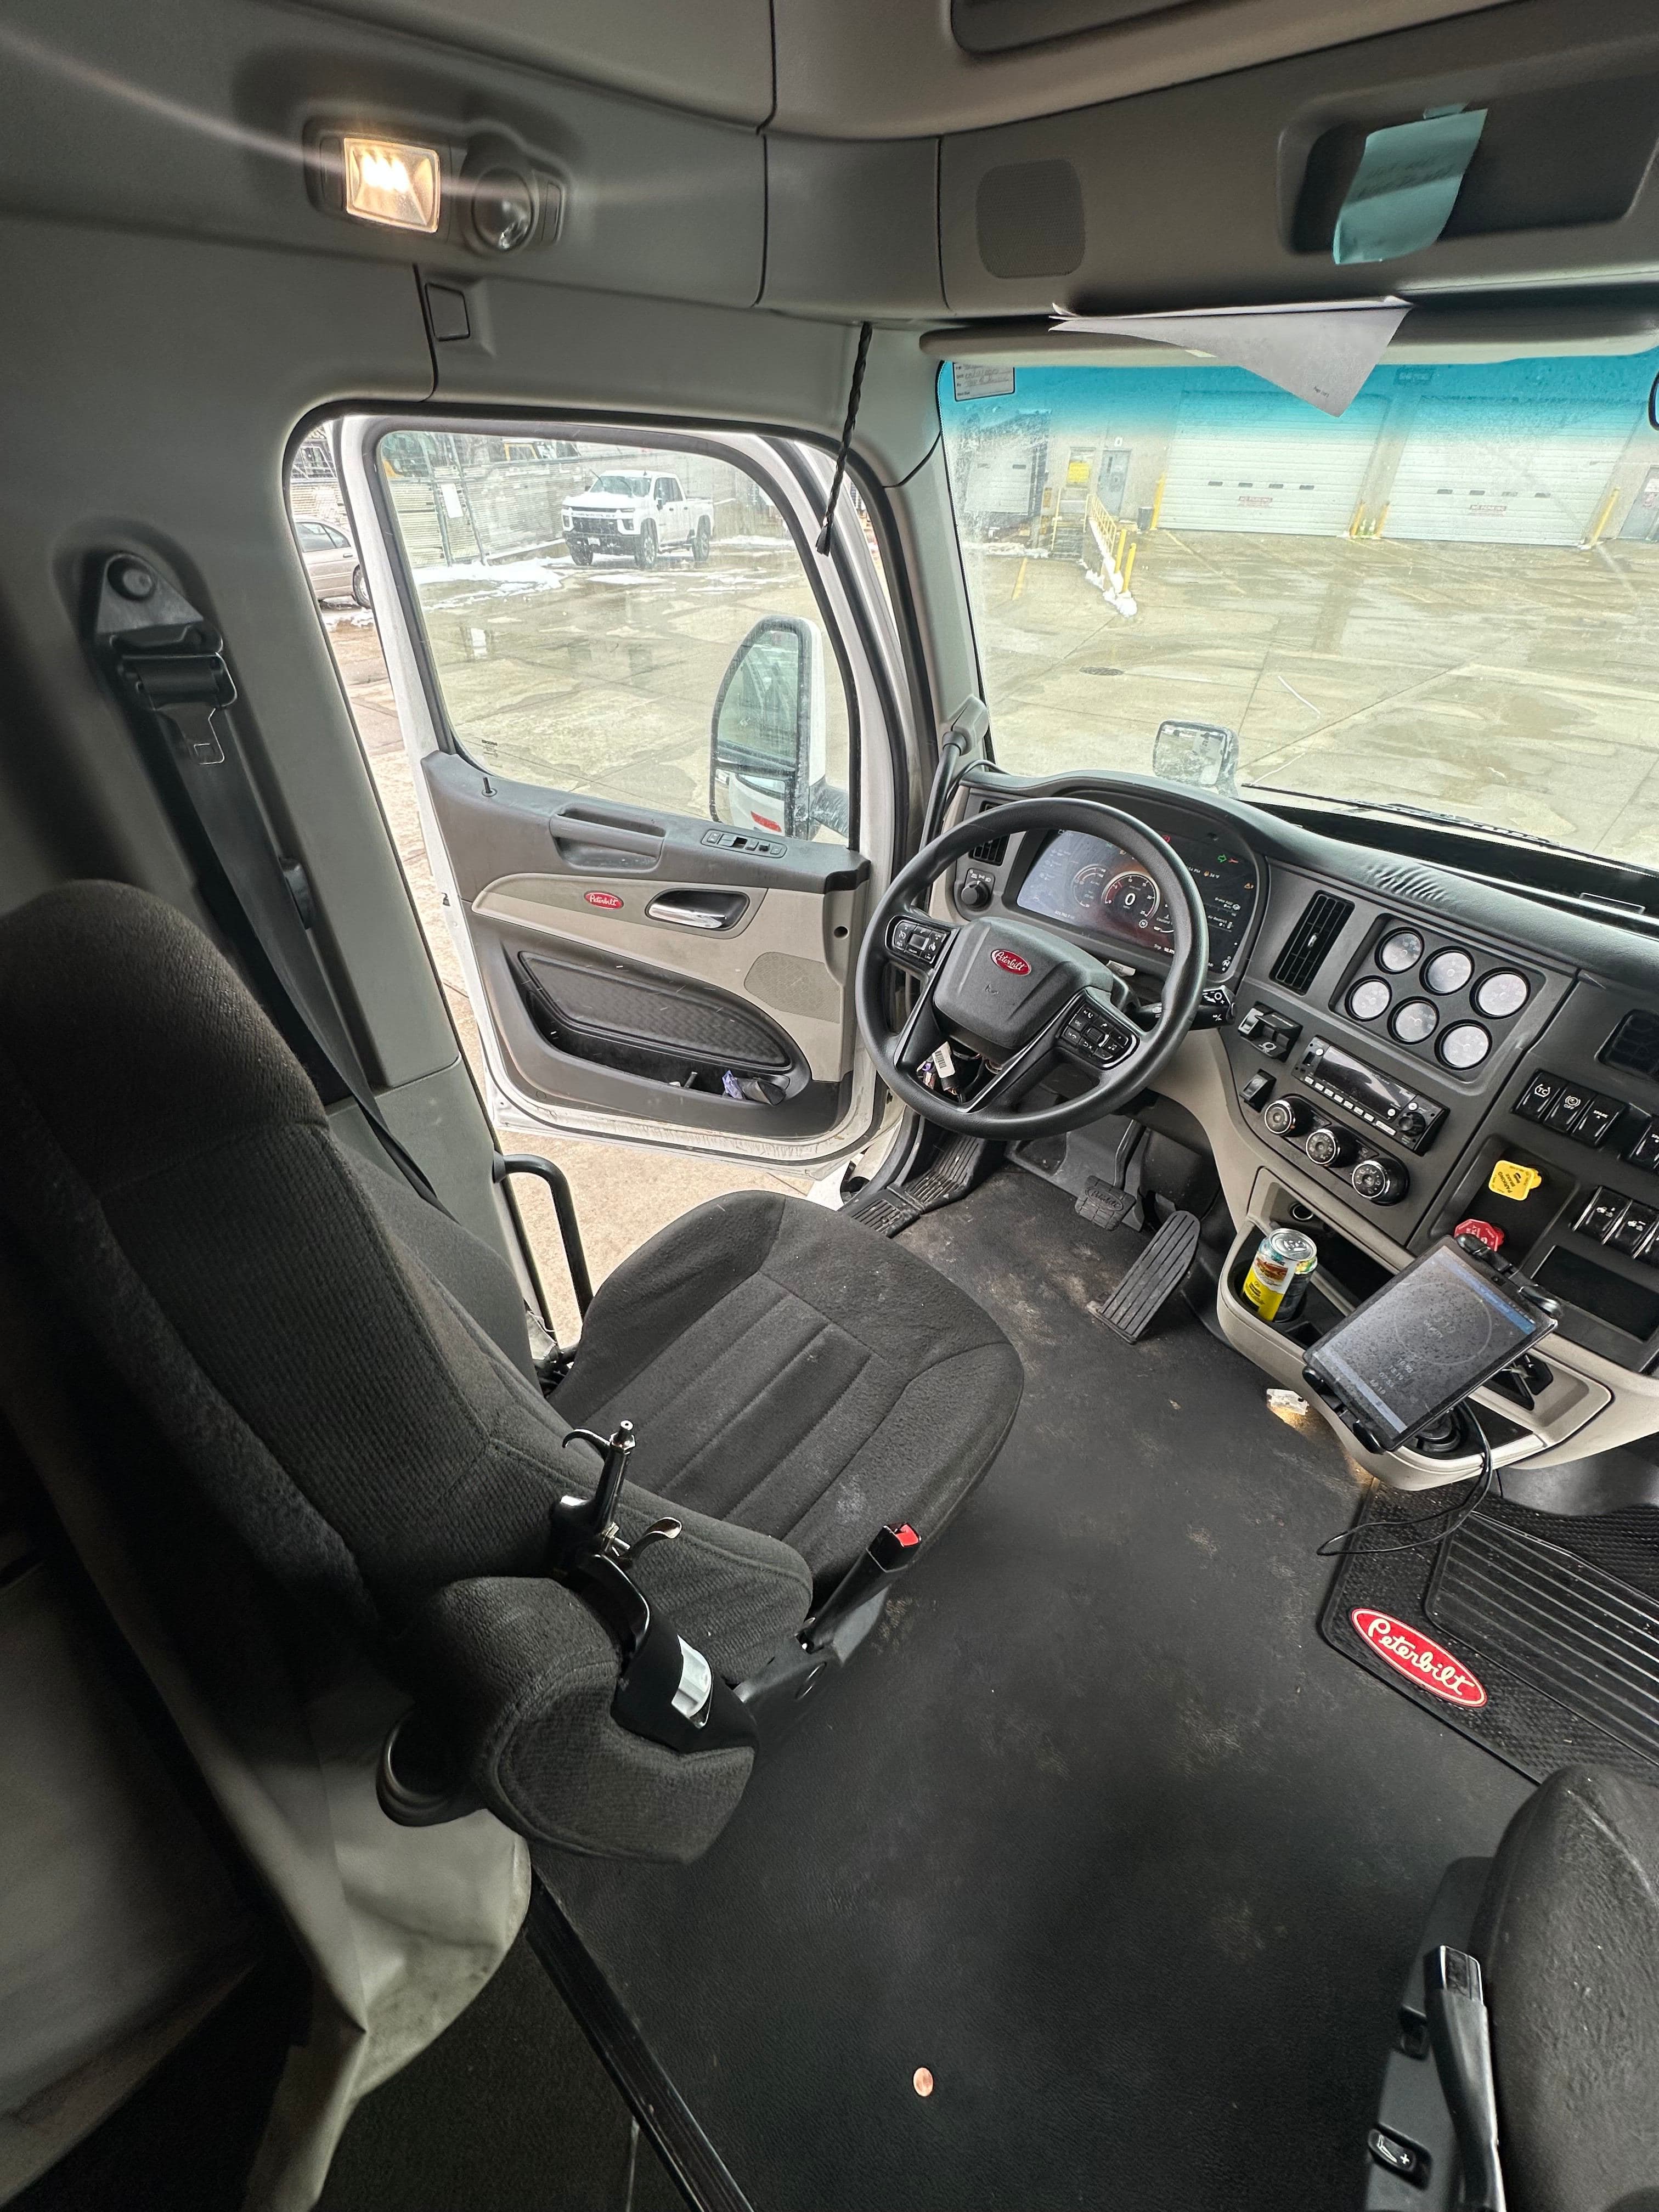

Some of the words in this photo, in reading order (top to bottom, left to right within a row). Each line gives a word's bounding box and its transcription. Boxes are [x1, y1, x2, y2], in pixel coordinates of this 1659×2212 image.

[590, 894, 619, 906] Peterbilt
[1125, 893, 1136, 906] 0
[995, 951, 1027, 971] Peterbilt
[1313, 1116, 1325, 1125] AUTO
[1498, 1171, 1513, 1193] PARKING
[1505, 1173, 1515, 1187] BRAKE
[1368, 1618, 1475, 1695] Peterbilt
